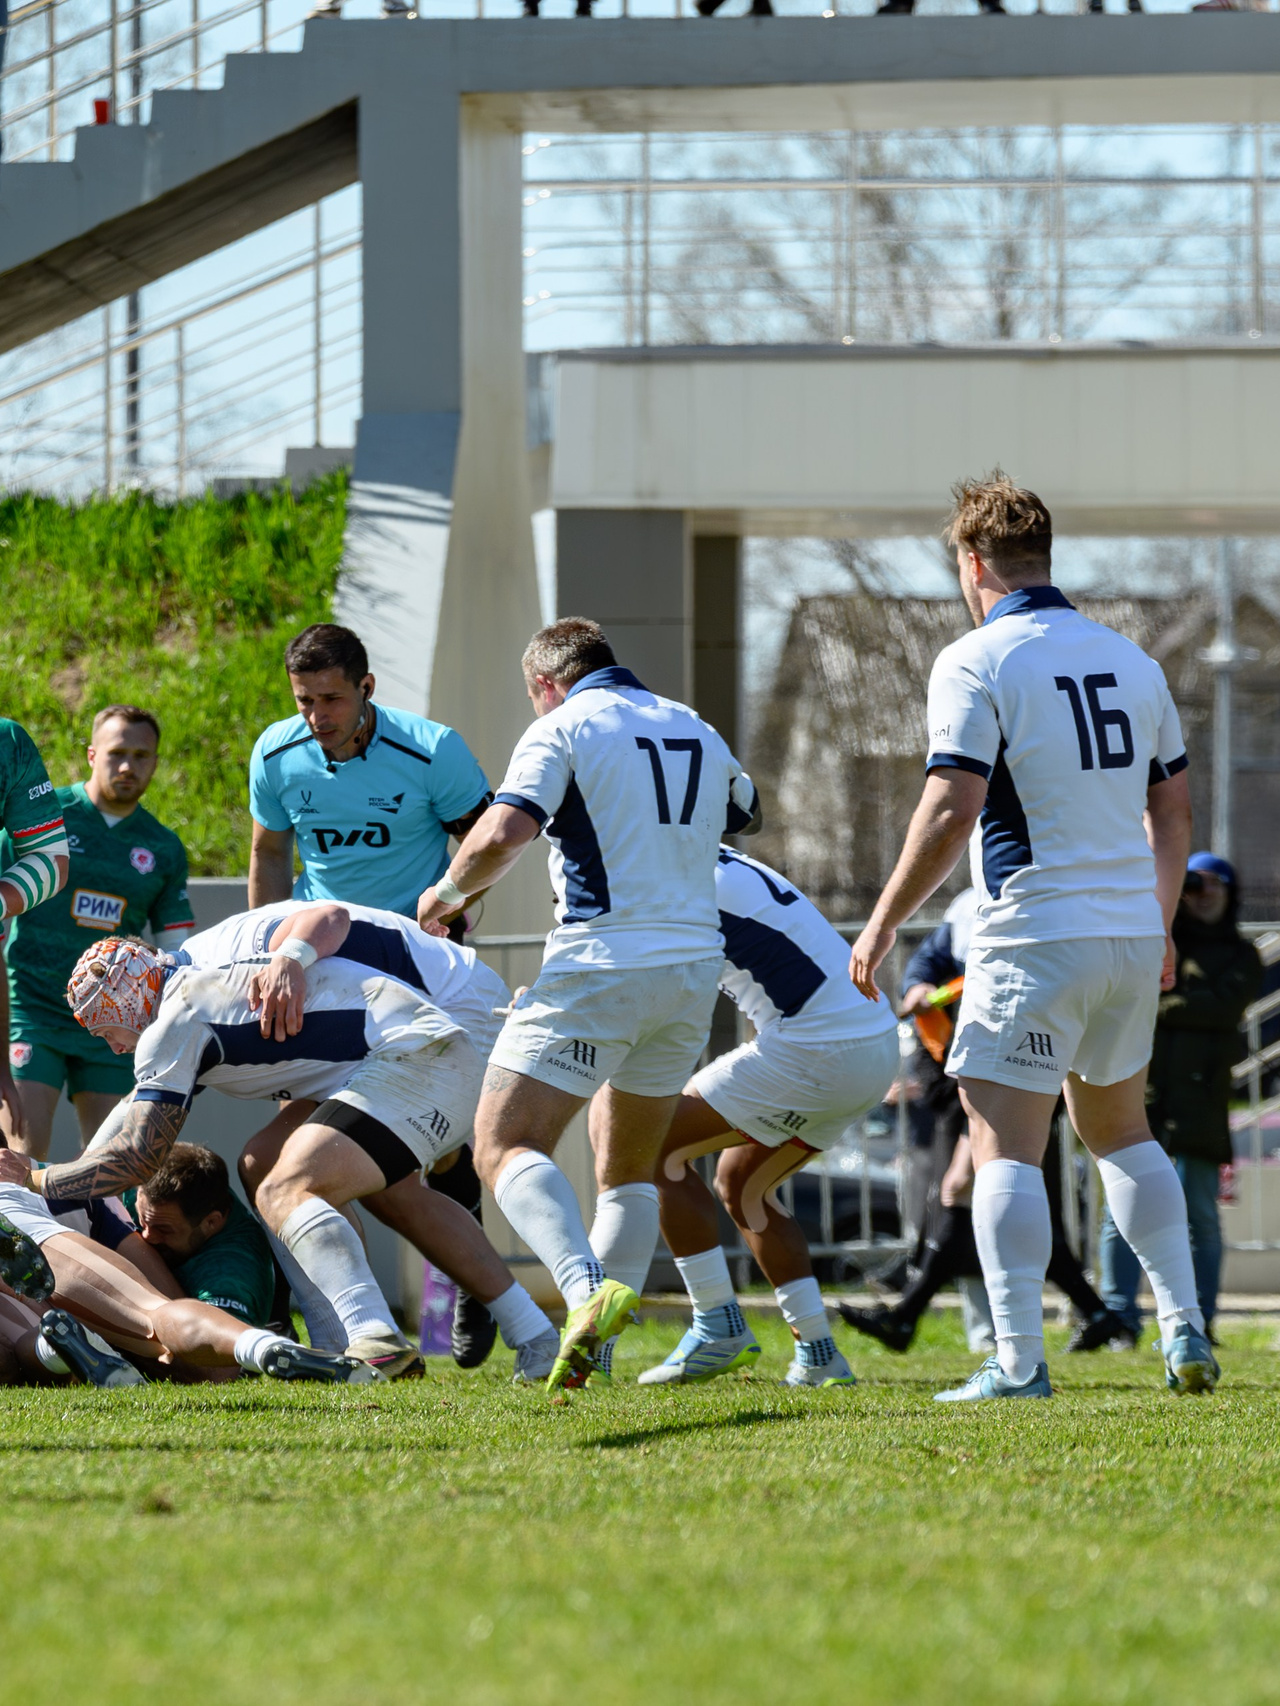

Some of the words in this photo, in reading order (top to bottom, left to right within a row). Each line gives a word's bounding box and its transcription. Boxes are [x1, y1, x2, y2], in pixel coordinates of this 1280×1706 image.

[1053, 672, 1135, 771] 16
[634, 736, 703, 826] 17
[76, 895, 121, 920] РИМ
[546, 1057, 598, 1082] ARBATHALL
[1004, 1055, 1060, 1072] ARBATHALL
